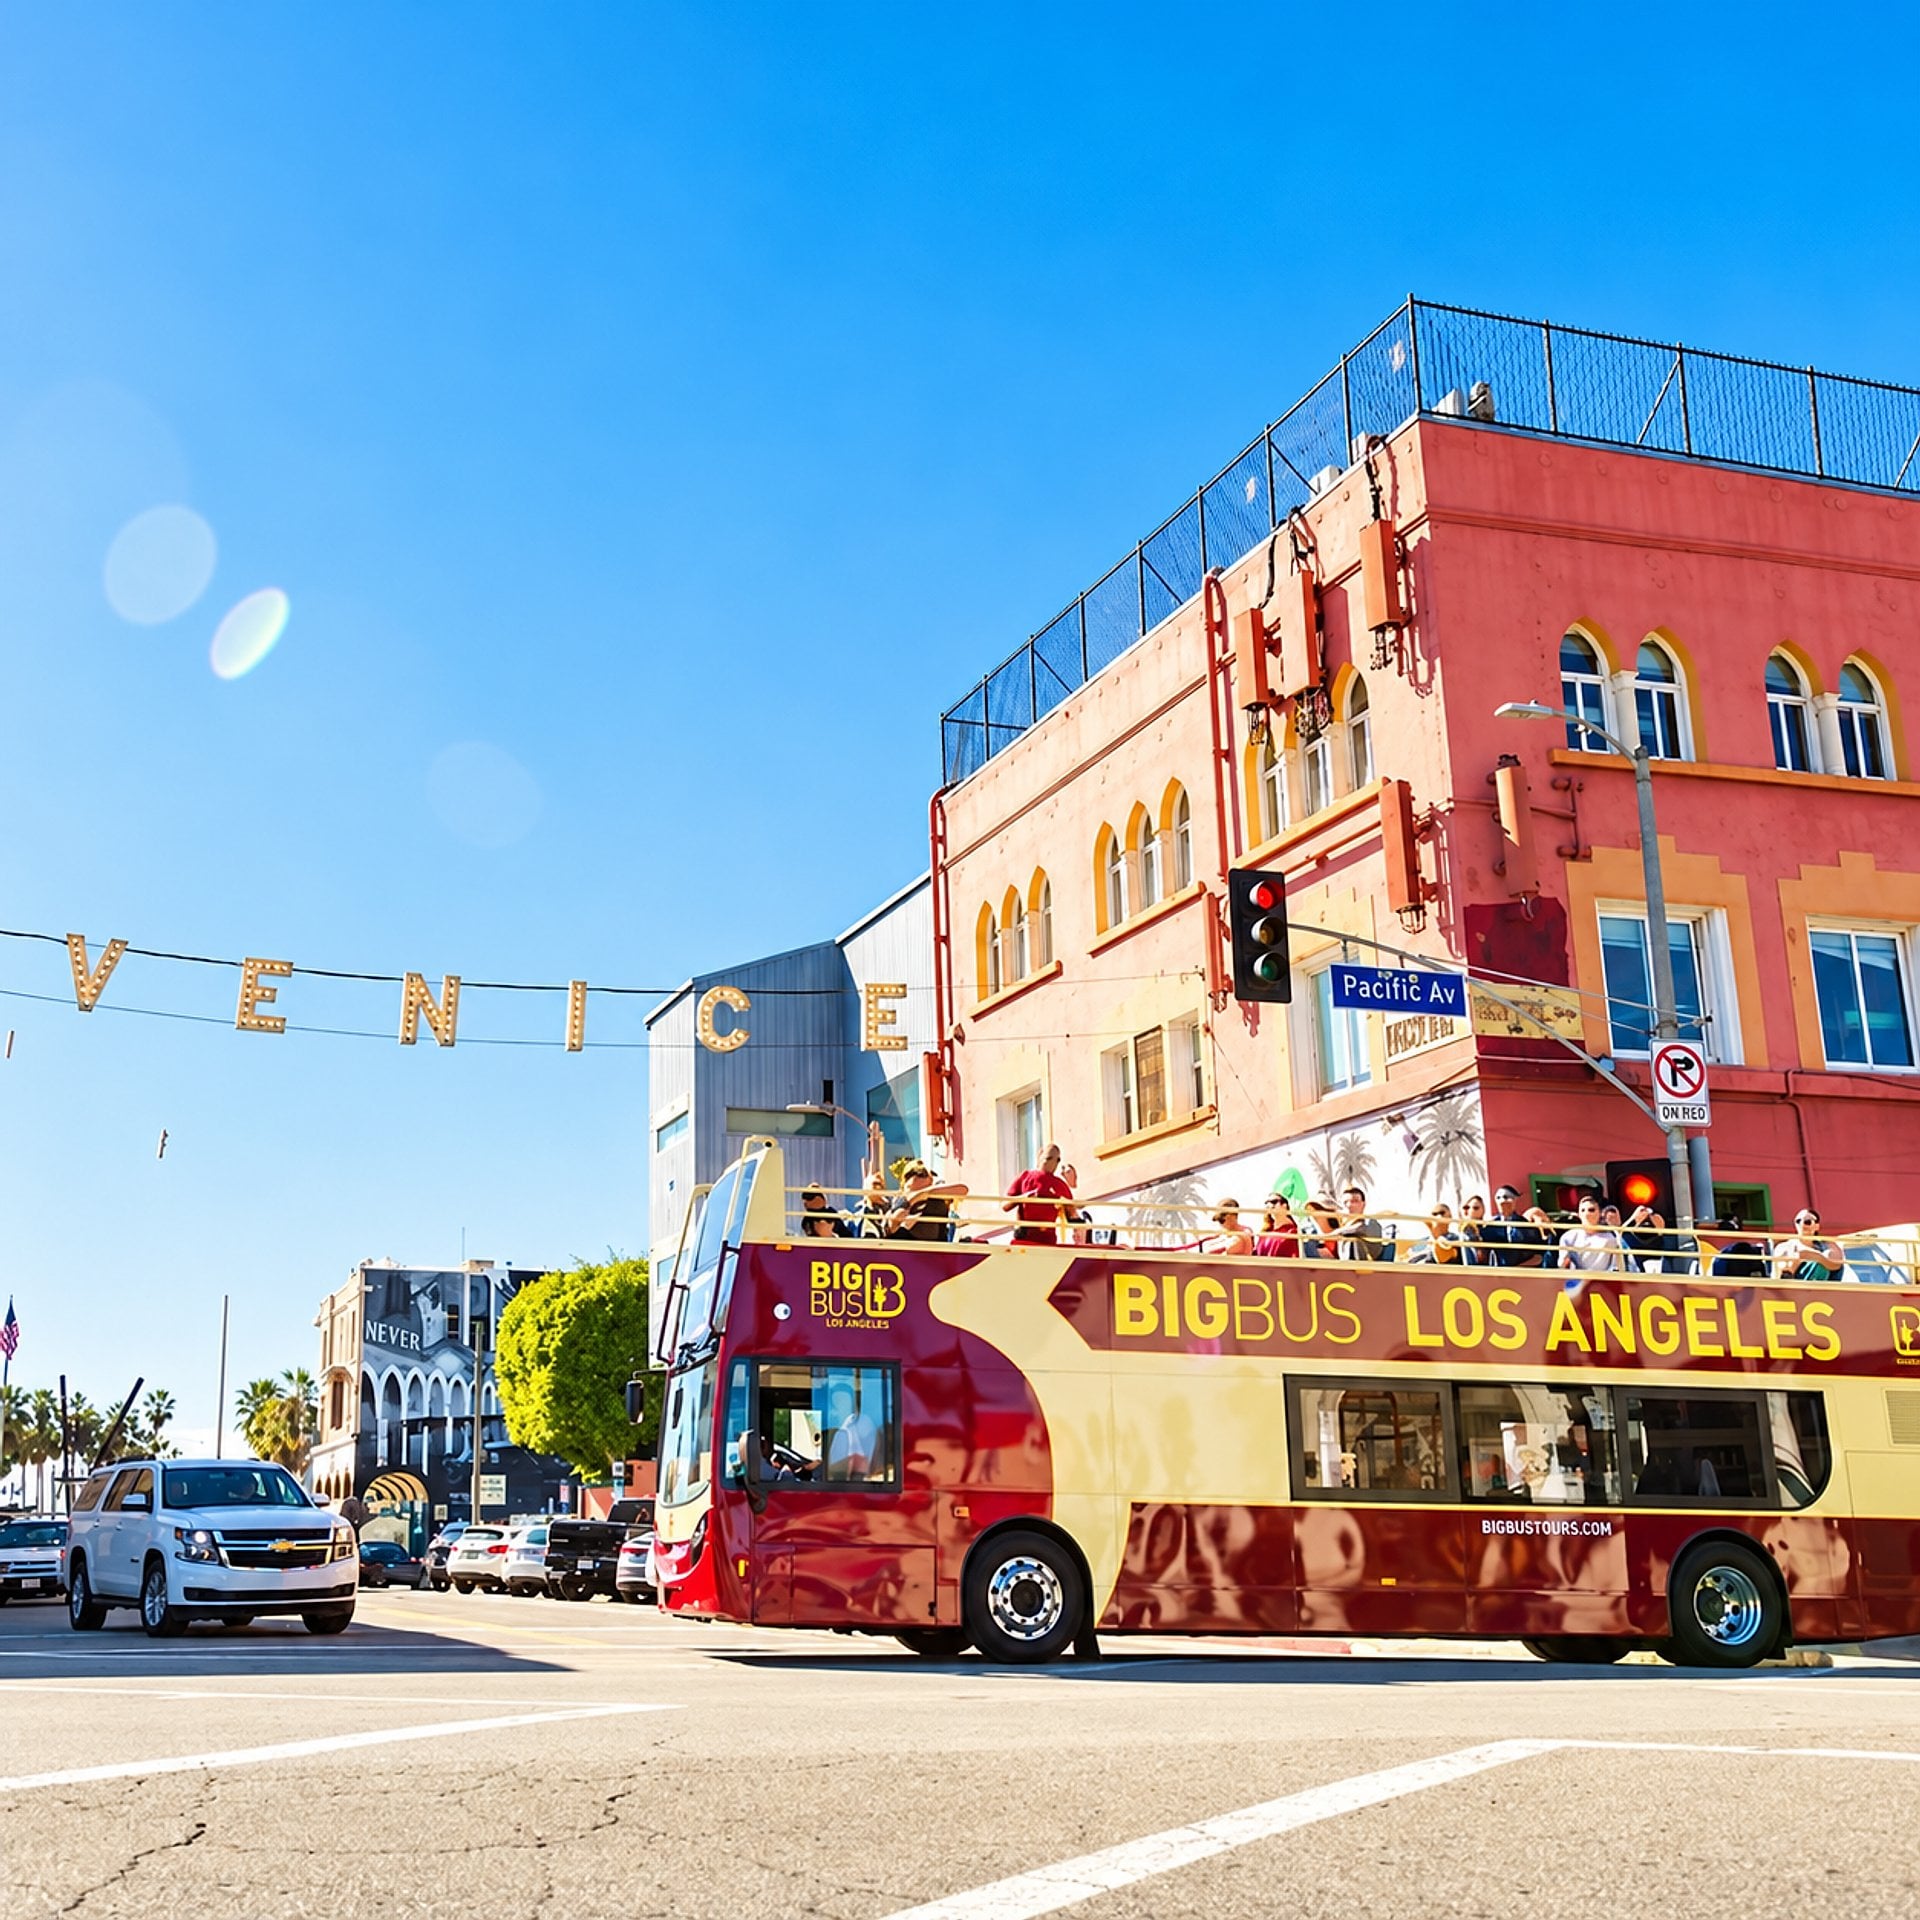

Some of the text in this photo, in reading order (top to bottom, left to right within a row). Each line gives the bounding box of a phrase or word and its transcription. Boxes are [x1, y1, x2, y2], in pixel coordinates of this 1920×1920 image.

[66, 933, 908, 1053] VENICE
[1343, 974, 1455, 1004] Pacific Av
[1662, 1106, 1705, 1120] ON RED
[811, 1261, 863, 1290] BIG
[811, 1291, 863, 1317] BUS
[365, 1320, 420, 1350] NEVER
[826, 1318, 889, 1329] LOS ANGELES
[1403, 1285, 1527, 1349] LOS
[1545, 1291, 1842, 1361] ANGELES
[1482, 1520, 1612, 1536] BIGBUSTOURS.COM
